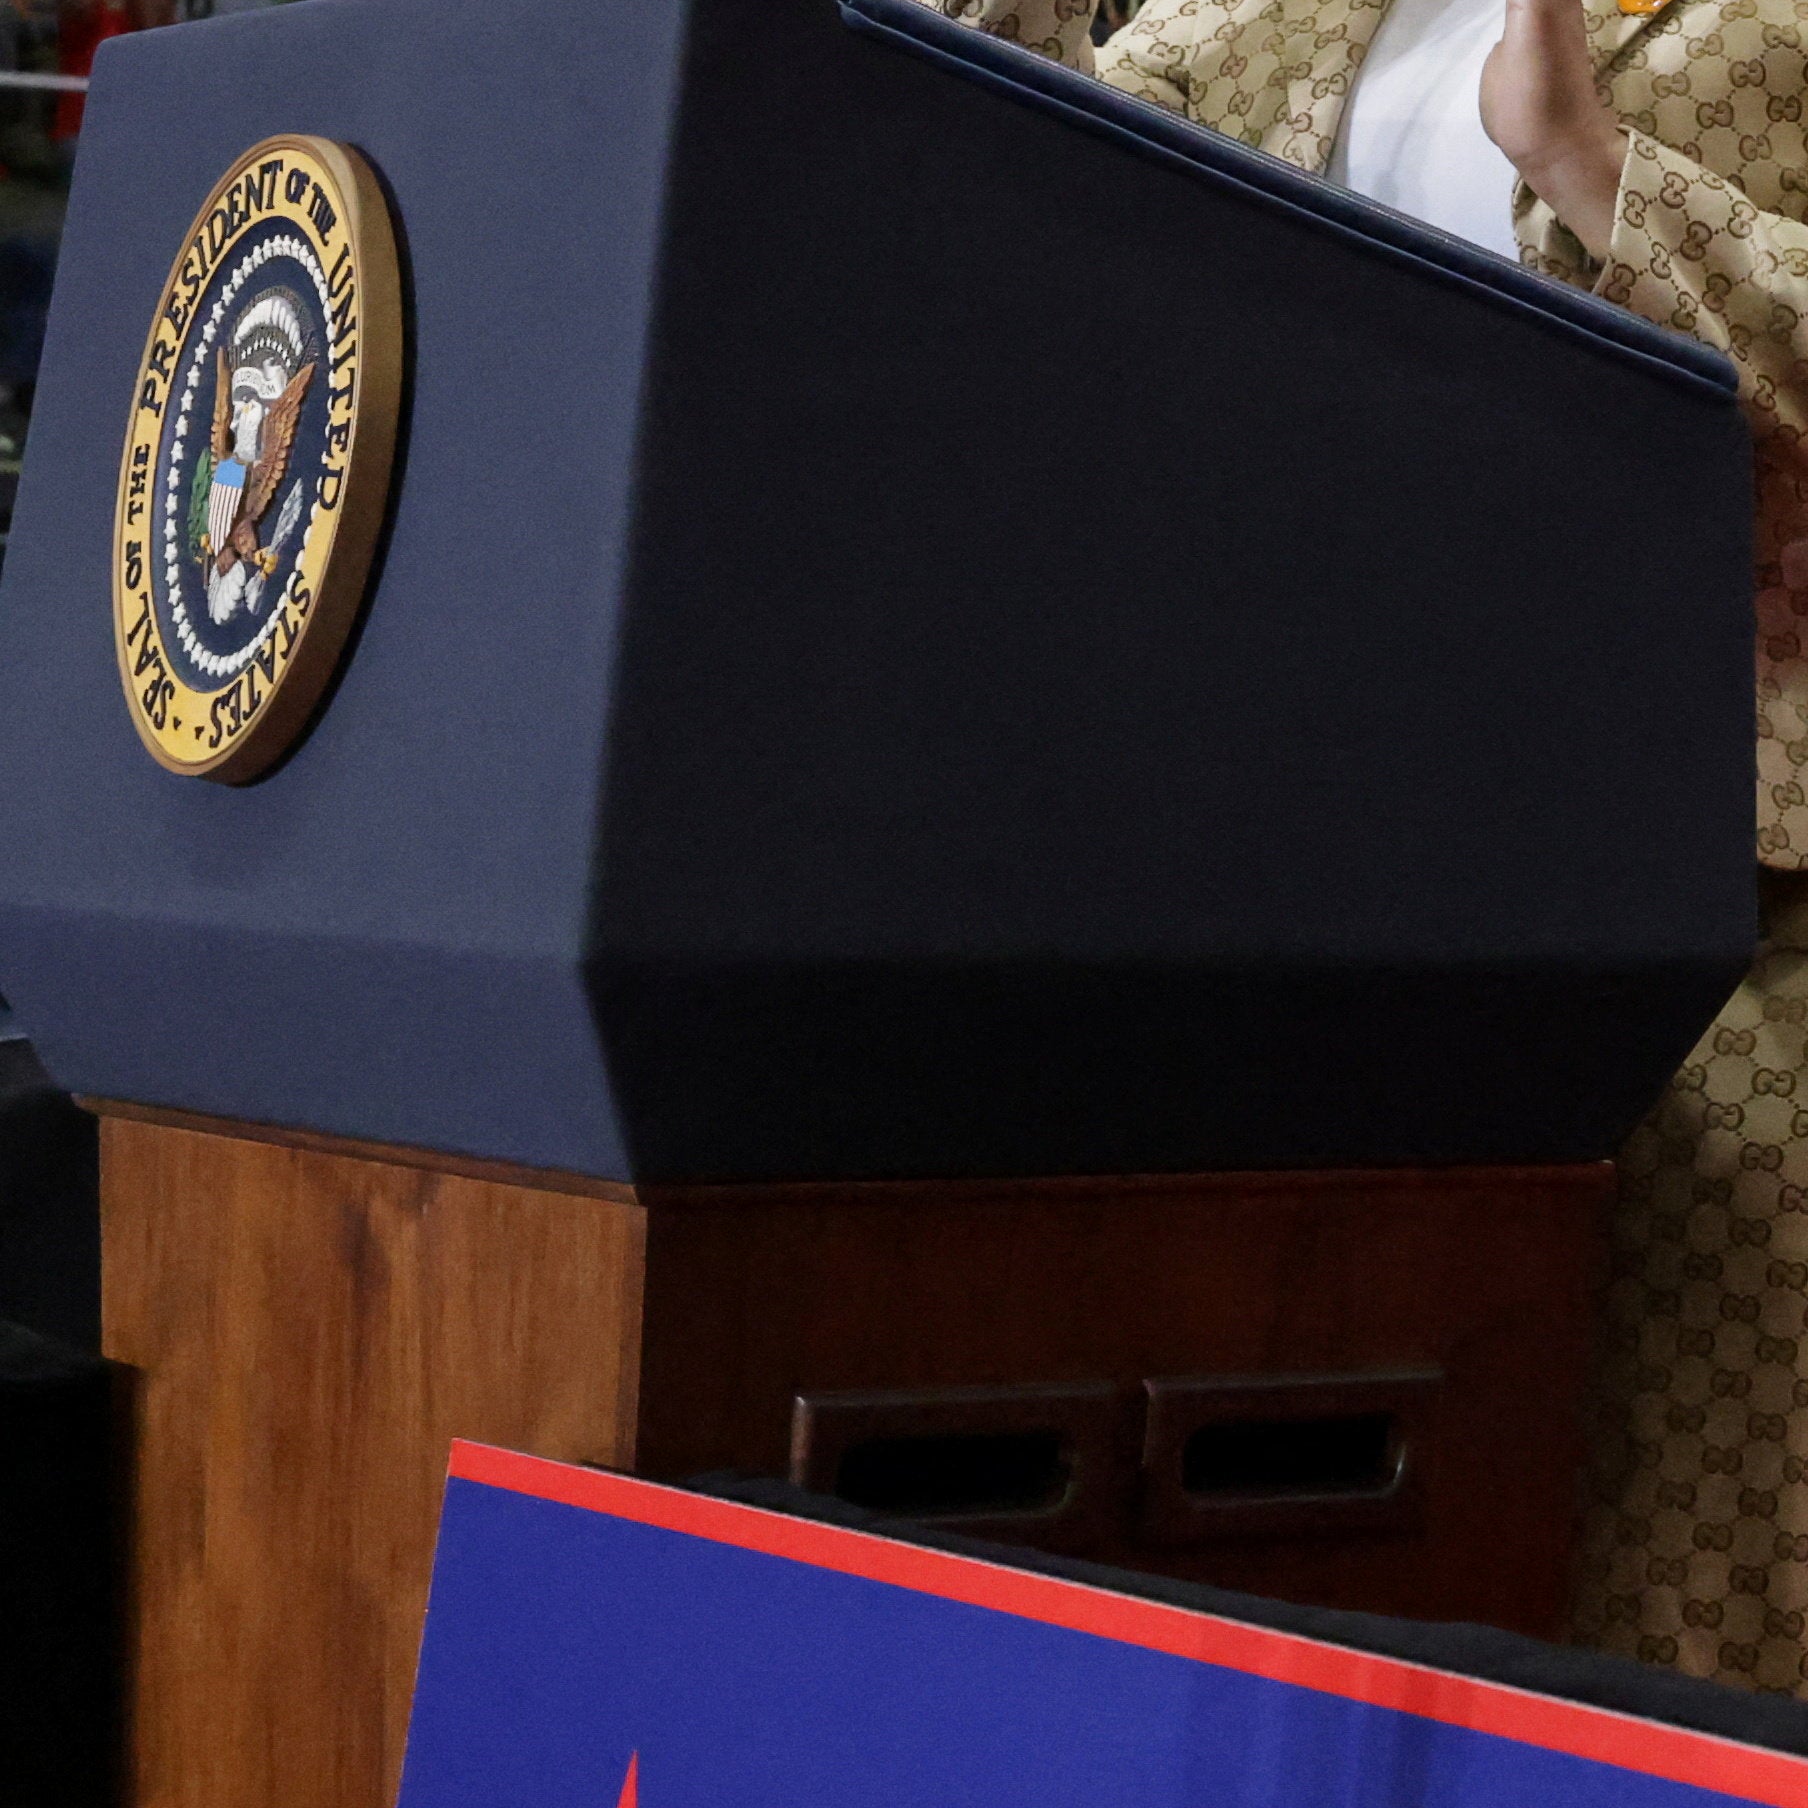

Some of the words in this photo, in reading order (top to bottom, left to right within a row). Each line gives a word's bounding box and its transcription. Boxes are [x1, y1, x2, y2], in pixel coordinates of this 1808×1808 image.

[285, 167, 311, 206] OF
[307, 181, 338, 248] THE
[140, 158, 284, 419] PRESIDENT
[319, 242, 358, 511] UNITED
[127, 443, 151, 526] THE
[125, 539, 143, 591] OF
[127, 591, 176, 731] SEAL
[208, 569, 311, 749] STATES
